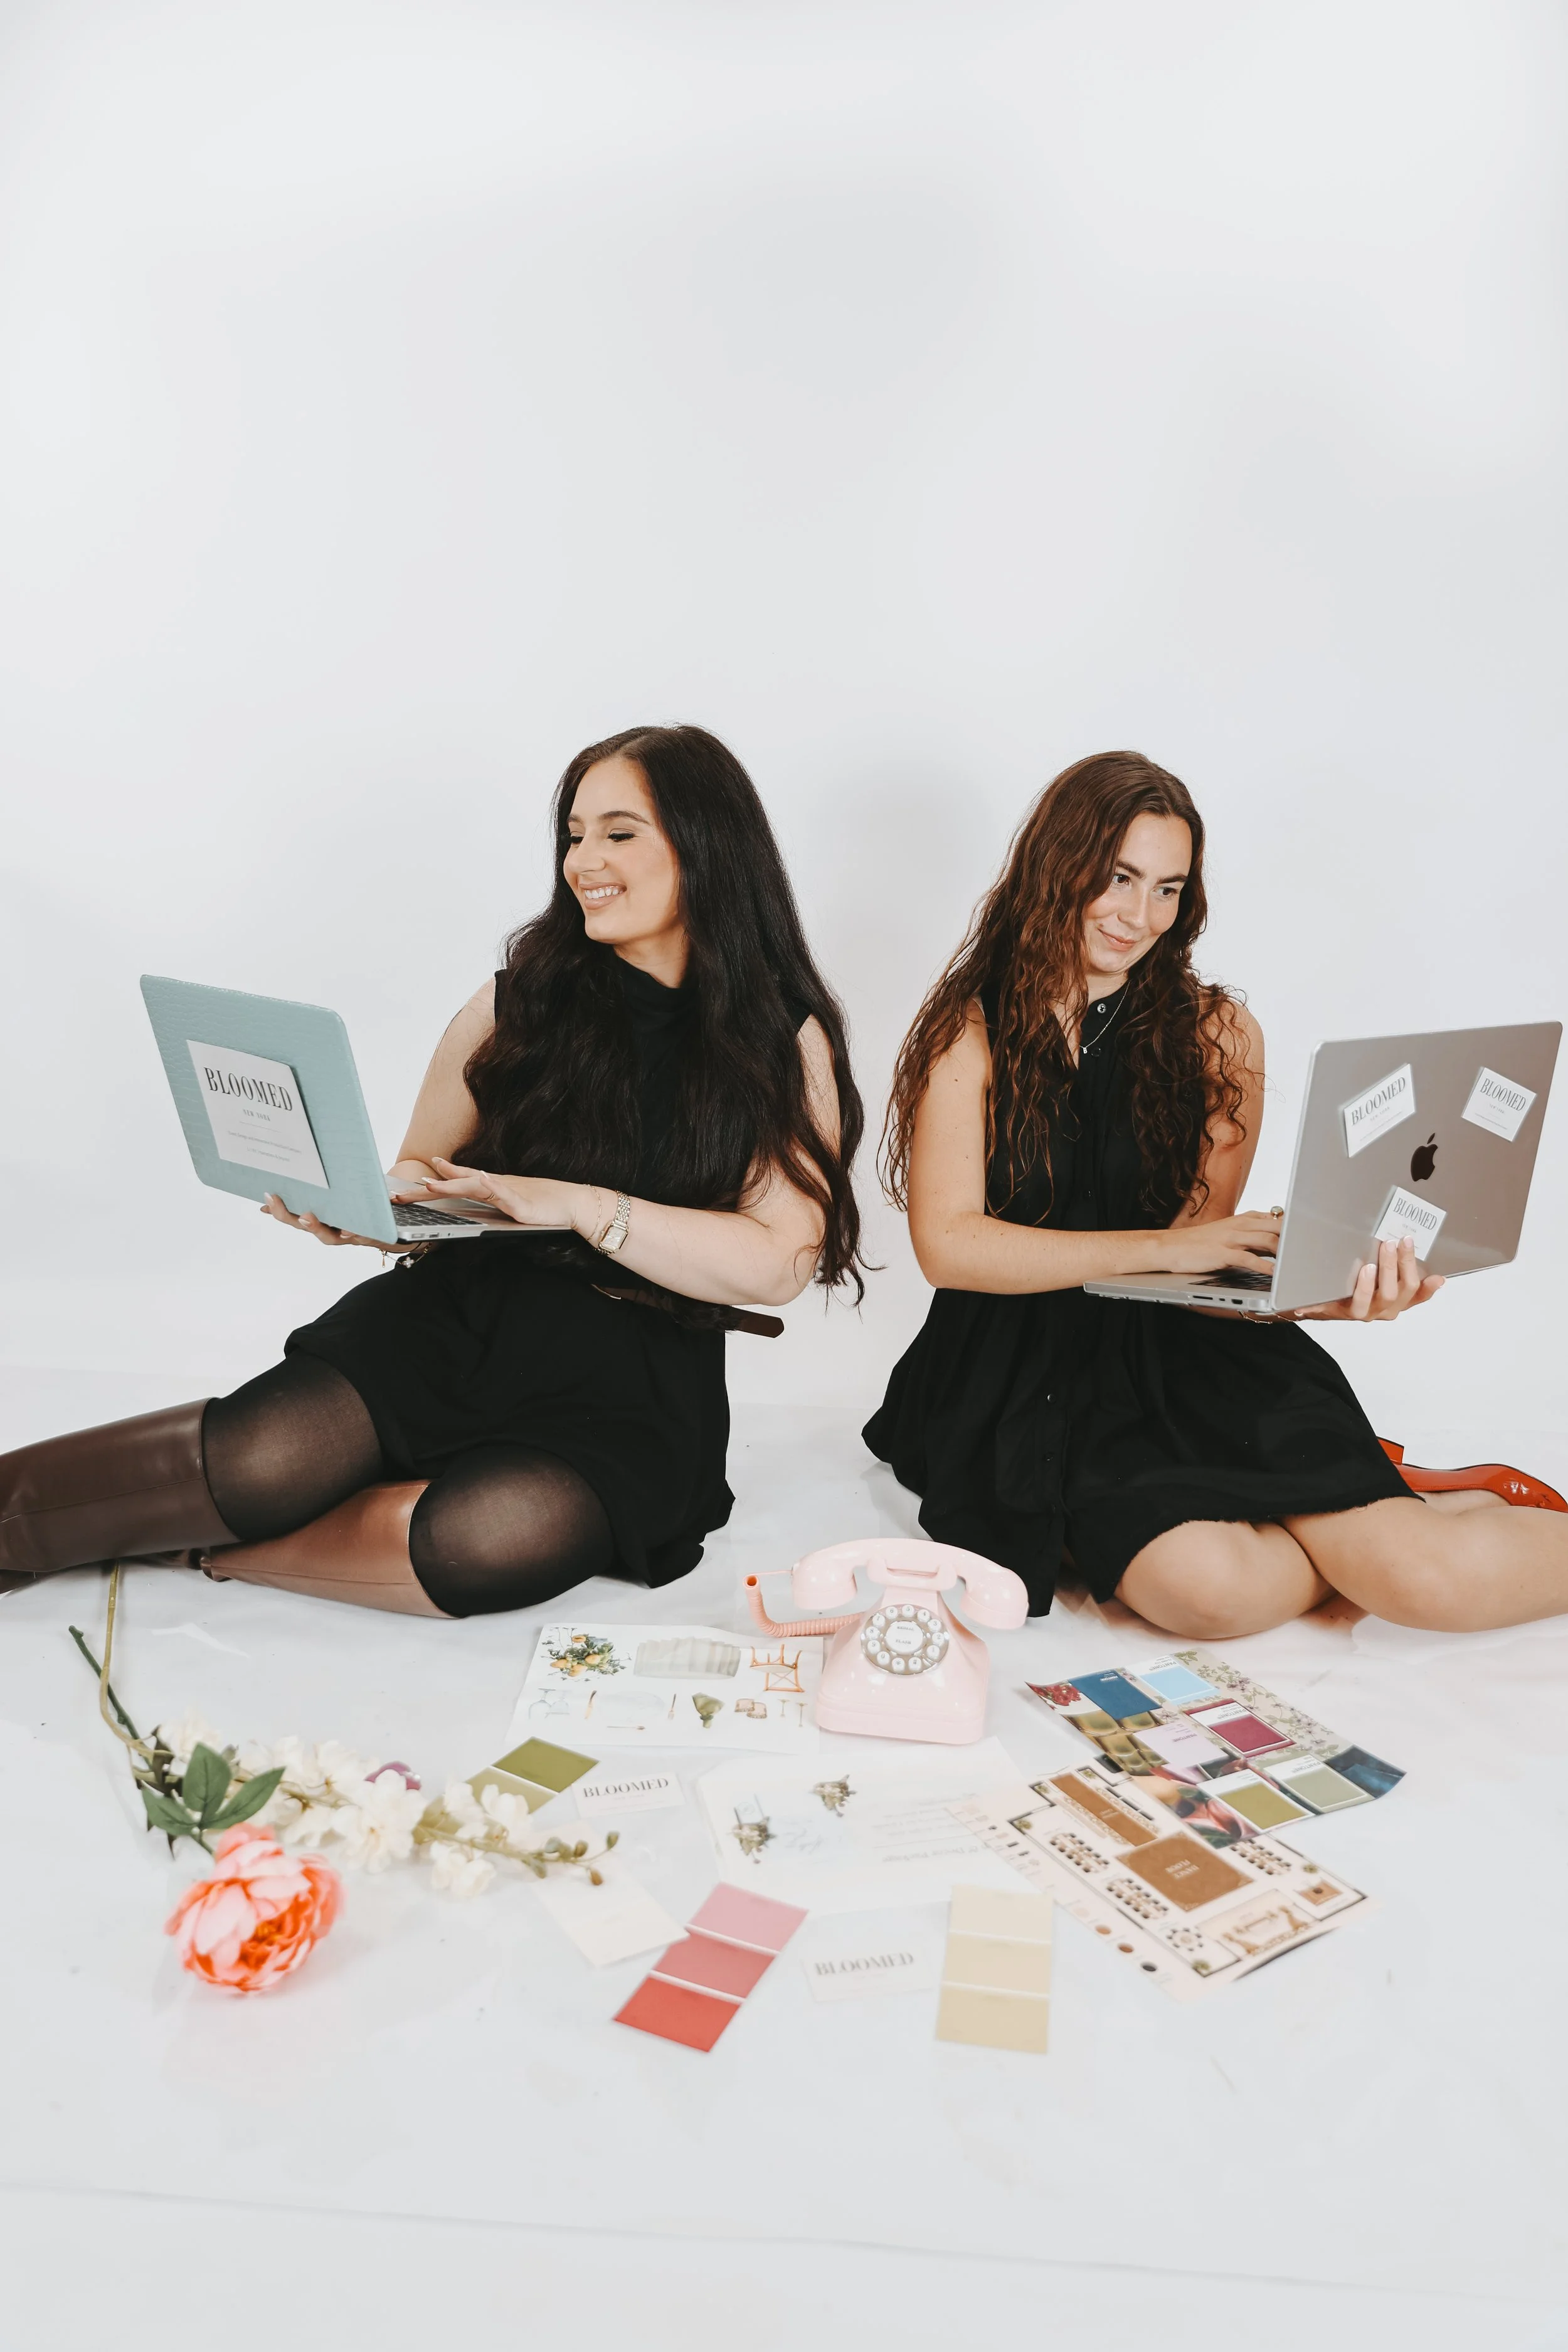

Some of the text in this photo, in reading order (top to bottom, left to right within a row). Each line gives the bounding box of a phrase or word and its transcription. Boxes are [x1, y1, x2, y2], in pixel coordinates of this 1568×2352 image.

[203, 1067, 293, 1111] BLOOMED
[1352, 1077, 1406, 1126] BLOOMED
[1480, 1078, 1526, 1111] BLOOMED
[1393, 1197, 1437, 1230] BLOOMED
[583, 1777, 669, 1798] BLOOMED
[1165, 1859, 1191, 1873] FLOOR
[815, 1952, 914, 1976] BLOOMED
